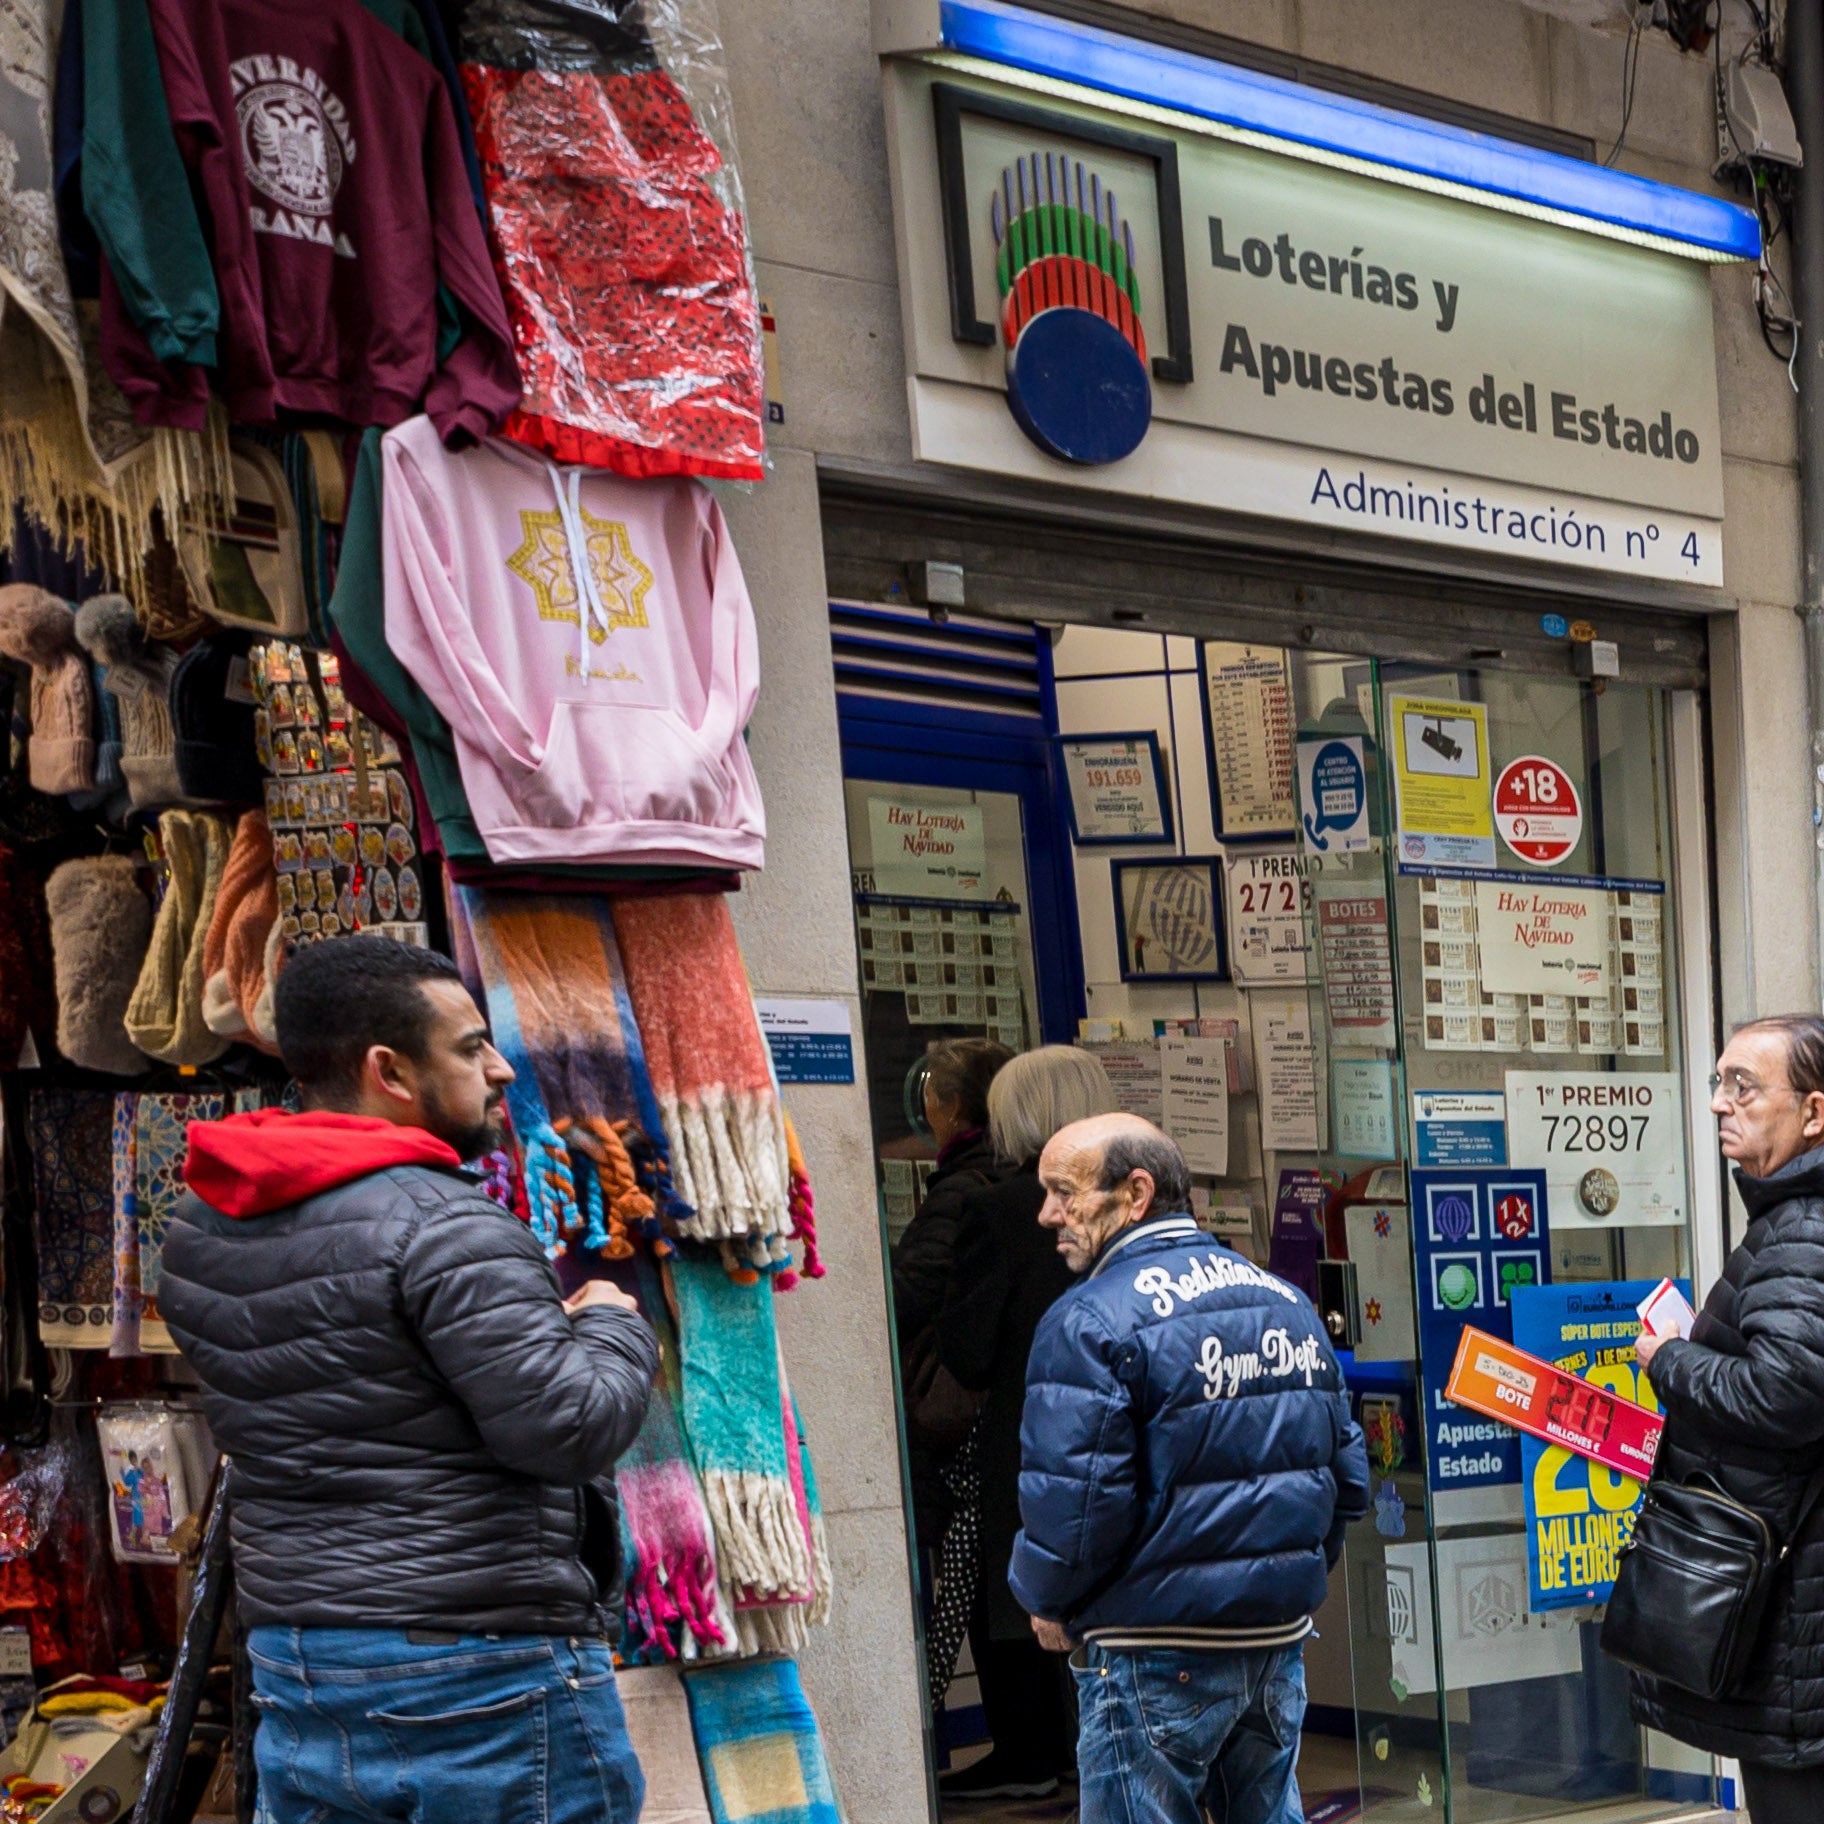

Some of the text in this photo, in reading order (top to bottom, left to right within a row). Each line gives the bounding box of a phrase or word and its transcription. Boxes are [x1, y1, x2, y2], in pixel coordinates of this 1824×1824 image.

[1208, 216, 1460, 332] Loterías y
[1220, 324, 1701, 464] Apuestas del Estado
[1310, 467, 1605, 553] Administración
[1680, 531, 1702, 568] 4
[1087, 768, 1142, 788] 191.659
[1510, 768, 1558, 804] +18
[888, 807, 913, 825] HAY
[903, 834, 955, 858] NAVIDAD
[1329, 901, 1376, 918] BOTES
[1498, 891, 1528, 912] HAY
[1515, 923, 1574, 949] NAVIDAD
[1534, 916, 1550, 928] DE
[1562, 1086, 1653, 1106] PREMIO
[1541, 1115, 1650, 1152] 72897
[1590, 1322, 1610, 1339] BOTE
[1194, 1327, 1327, 1400] Gym. Dept.
[1604, 1349, 1616, 1365] DE
[1495, 1383, 1532, 1411] BOTE
[1546, 1376, 1616, 1443] 217
[1437, 1419, 1519, 1448] Apuesta
[1546, 1422, 1595, 1451] MILLONES
[1439, 1452, 1502, 1479] Estado
[1537, 1510, 1636, 1555] MILLONES
[1539, 1553, 1566, 1590] DE
